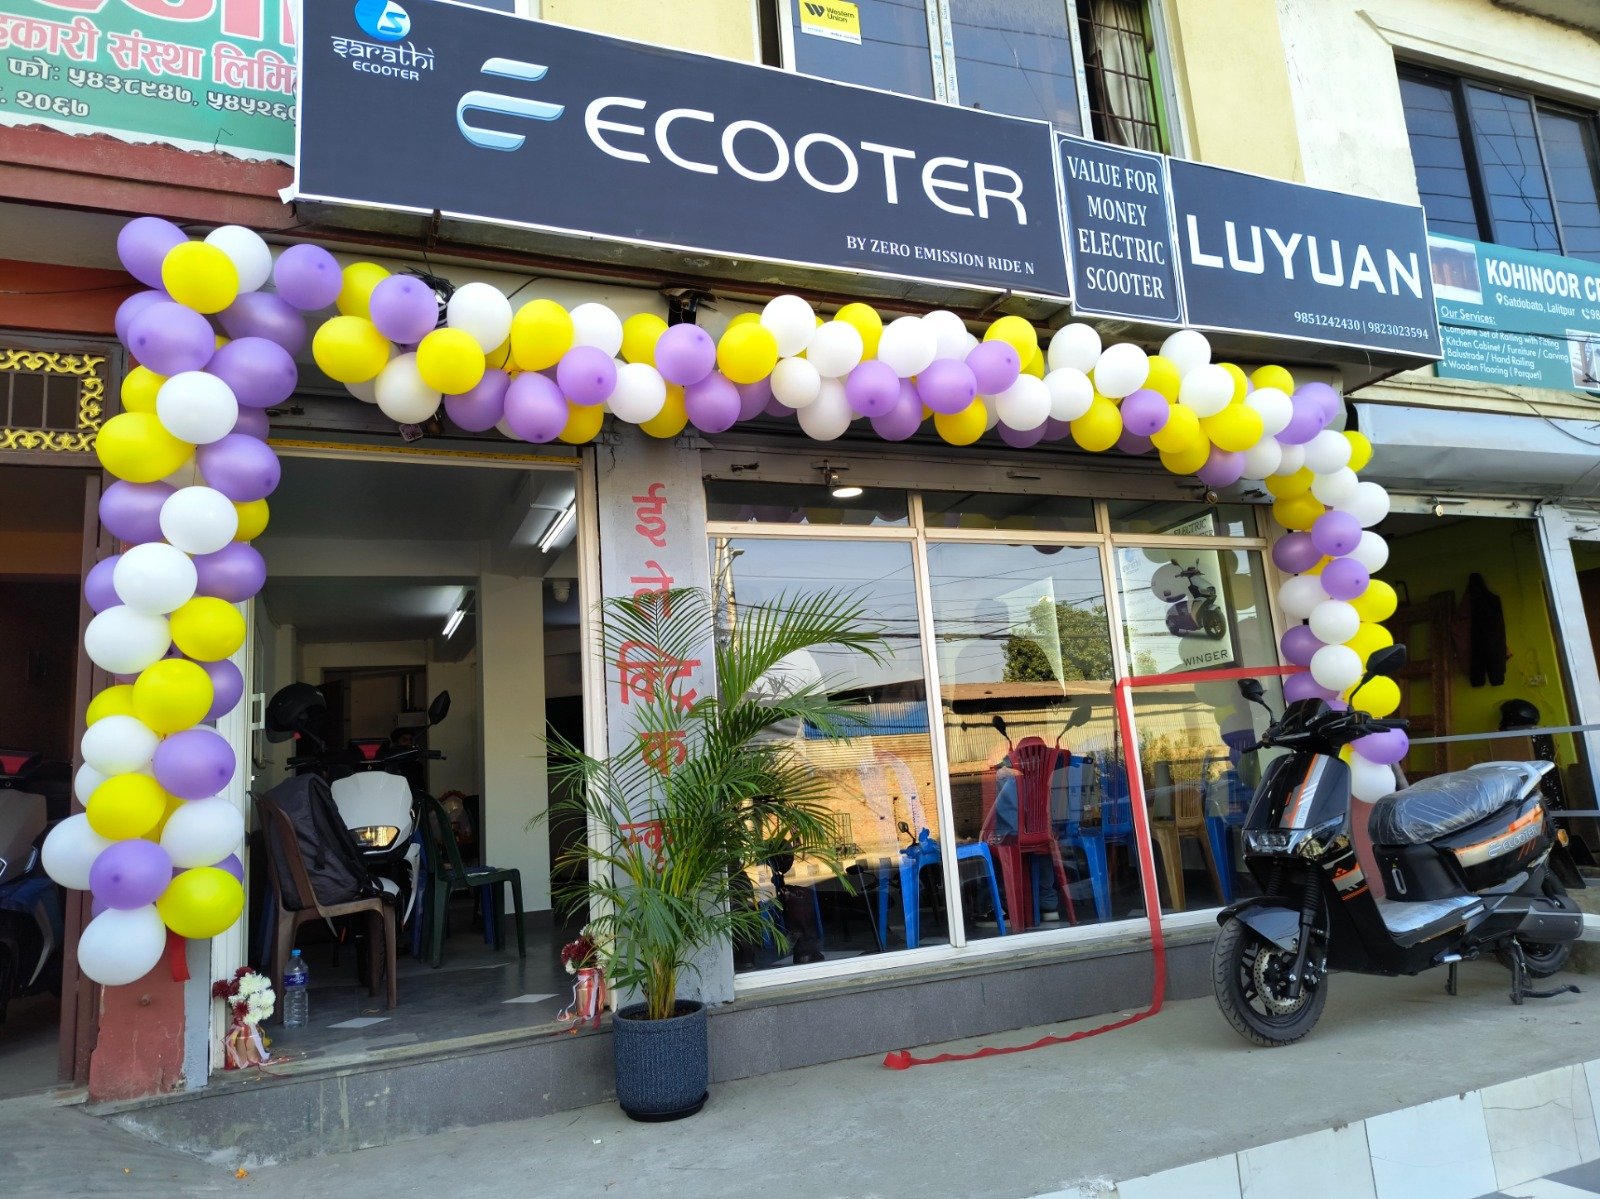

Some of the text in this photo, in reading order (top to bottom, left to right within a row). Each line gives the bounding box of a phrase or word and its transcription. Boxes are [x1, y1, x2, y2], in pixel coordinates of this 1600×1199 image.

[826, 7, 855, 19] Western
[827, 13, 848, 23] Union
[107, 29, 205, 80] संस्था
[212, 41, 297, 96] लिमि
[352, 60, 420, 82] ECOOTER
[15, 90, 91, 118] २०६७
[584, 96, 1028, 226] ECOOTER
[1066, 155, 1160, 196] VALUE FOR
[1087, 194, 1148, 228] MONEY
[846, 235, 1036, 276] BY ZERO EMISSION RIDE N
[1078, 227, 1166, 266] ELECTRIC
[1186, 213, 1424, 300] LUYUAN
[1086, 266, 1166, 300] SCOOTER
[1485, 257, 1582, 300] KOHINOOR
[1441, 305, 1496, 325] Our Services:
[1546, 302, 1576, 317] Lalitpur
[1293, 310, 1361, 332] 9851242430
[1367, 320, 1430, 341] 9823023594
[1446, 336, 1472, 348] Kitchen
[1473, 340, 1501, 350] Cabinet
[1507, 344, 1537, 357] Furniture
[1543, 349, 1570, 363] Carving
[1447, 347, 1485, 361] Balustrade
[1491, 353, 1511, 365] Hand
[1511, 355, 1535, 370] Railing
[1448, 360, 1479, 371] Wooden
[1480, 363, 1509, 378] Flooring
[1183, 649, 1229, 667] WINGER
